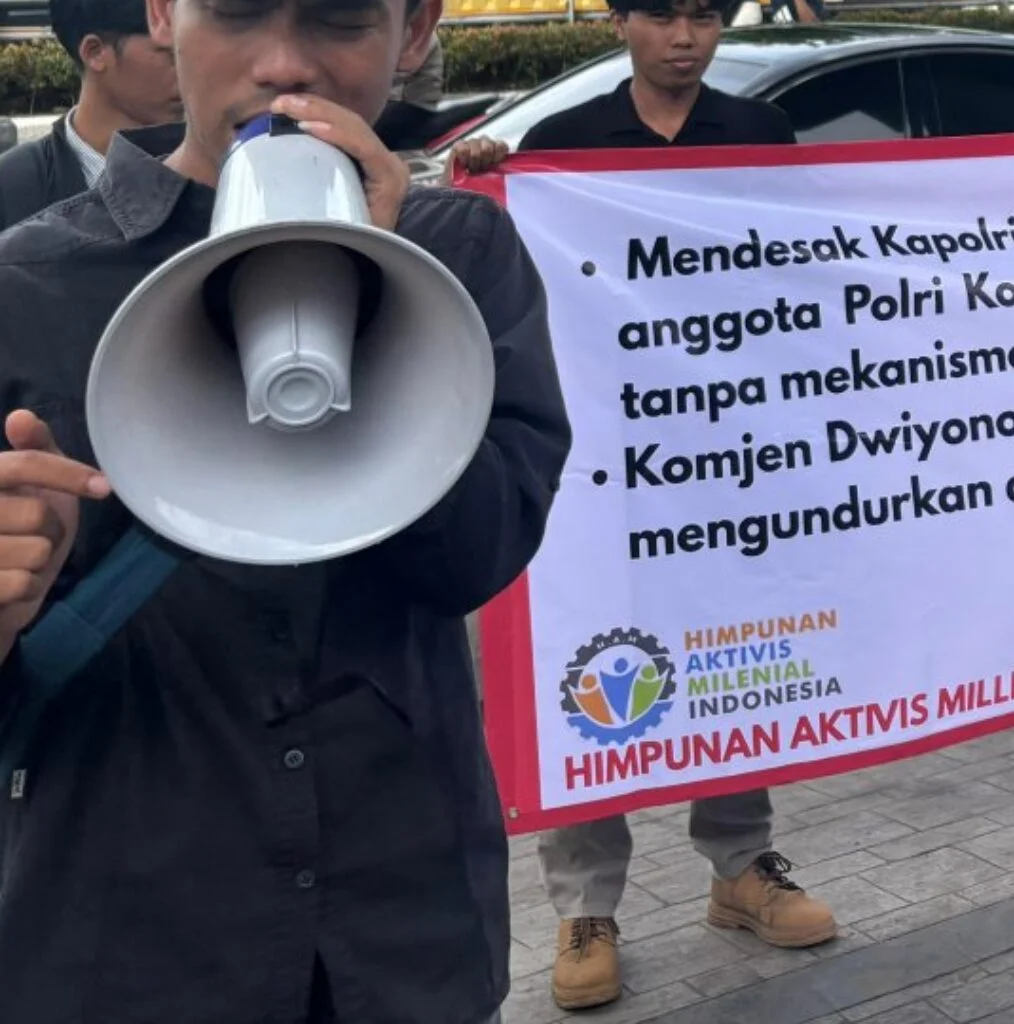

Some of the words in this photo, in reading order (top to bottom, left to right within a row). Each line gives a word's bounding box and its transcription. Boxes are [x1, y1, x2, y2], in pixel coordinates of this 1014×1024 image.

[627, 225, 869, 281] Mendesak
[617, 297, 821, 356] anggota
[844, 276, 944, 325] Polri
[619, 377, 767, 424] tanpa
[624, 432, 812, 490] Komjen
[629, 475, 993, 560] mengundurkan
[684, 609, 838, 651] HIMPUNAN
[685, 639, 793, 674] AKTIVIS
[687, 659, 816, 697] MILENIAL
[688, 676, 843, 720] INDONESIA
[564, 721, 780, 791] HIMPUNAN
[789, 694, 930, 752] AKTIVIS
